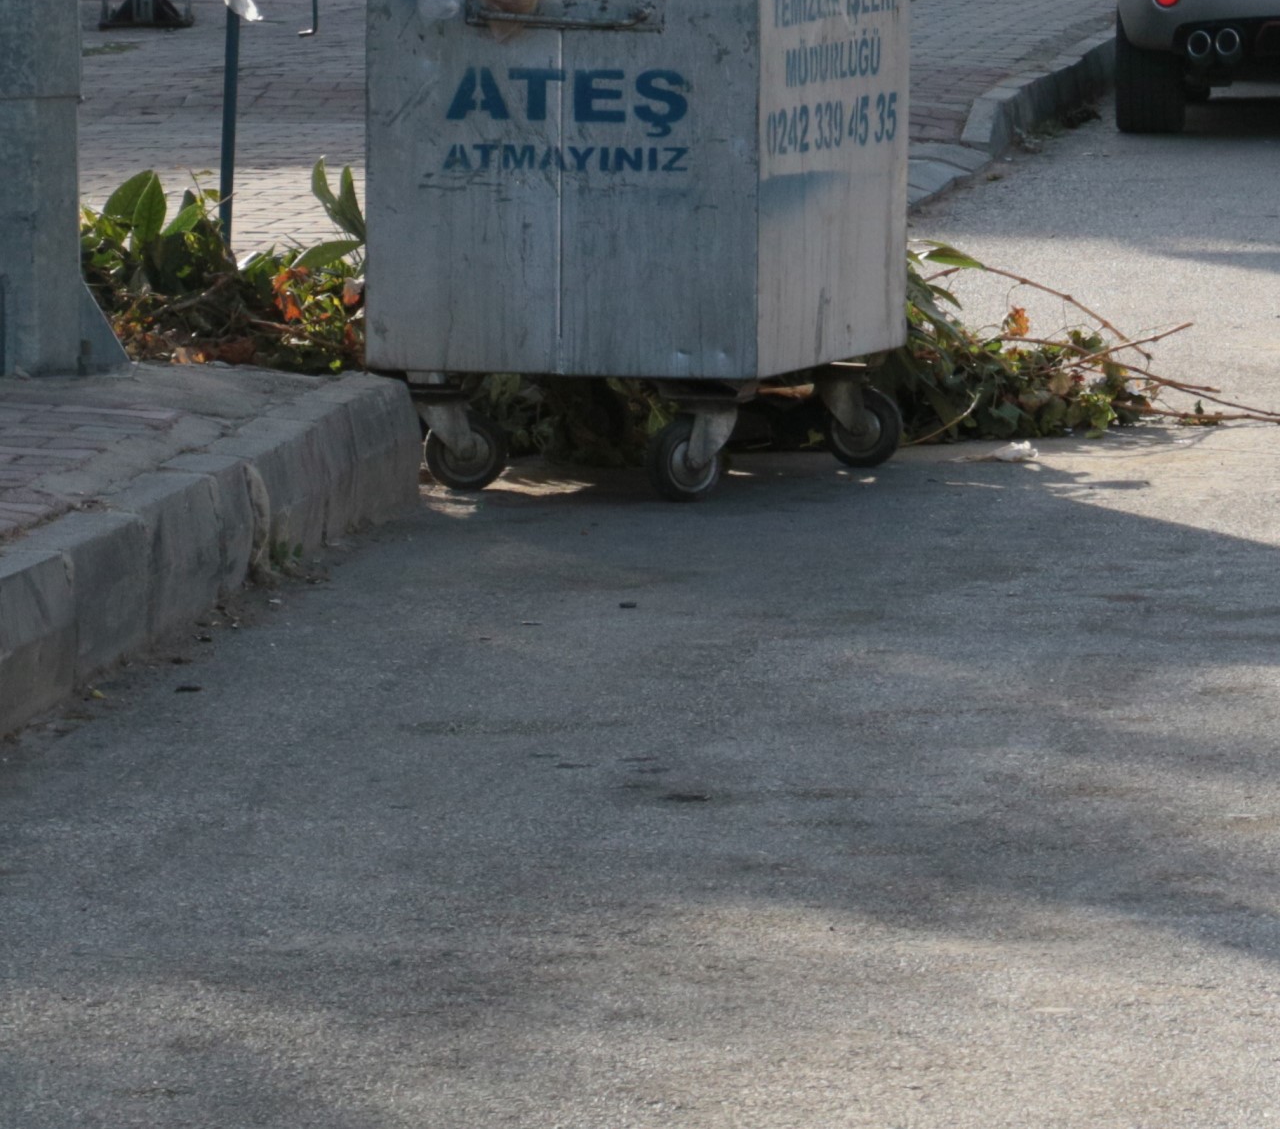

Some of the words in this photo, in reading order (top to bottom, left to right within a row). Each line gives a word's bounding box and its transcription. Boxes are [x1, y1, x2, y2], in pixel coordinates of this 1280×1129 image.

[446, 66, 690, 138] ATEŞ
[766, 104, 810, 159] 0242
[814, 100, 844, 151] 339
[848, 94, 870, 147] 45
[874, 91, 898, 144] 35
[442, 143, 690, 172] ATMAYINIZ
